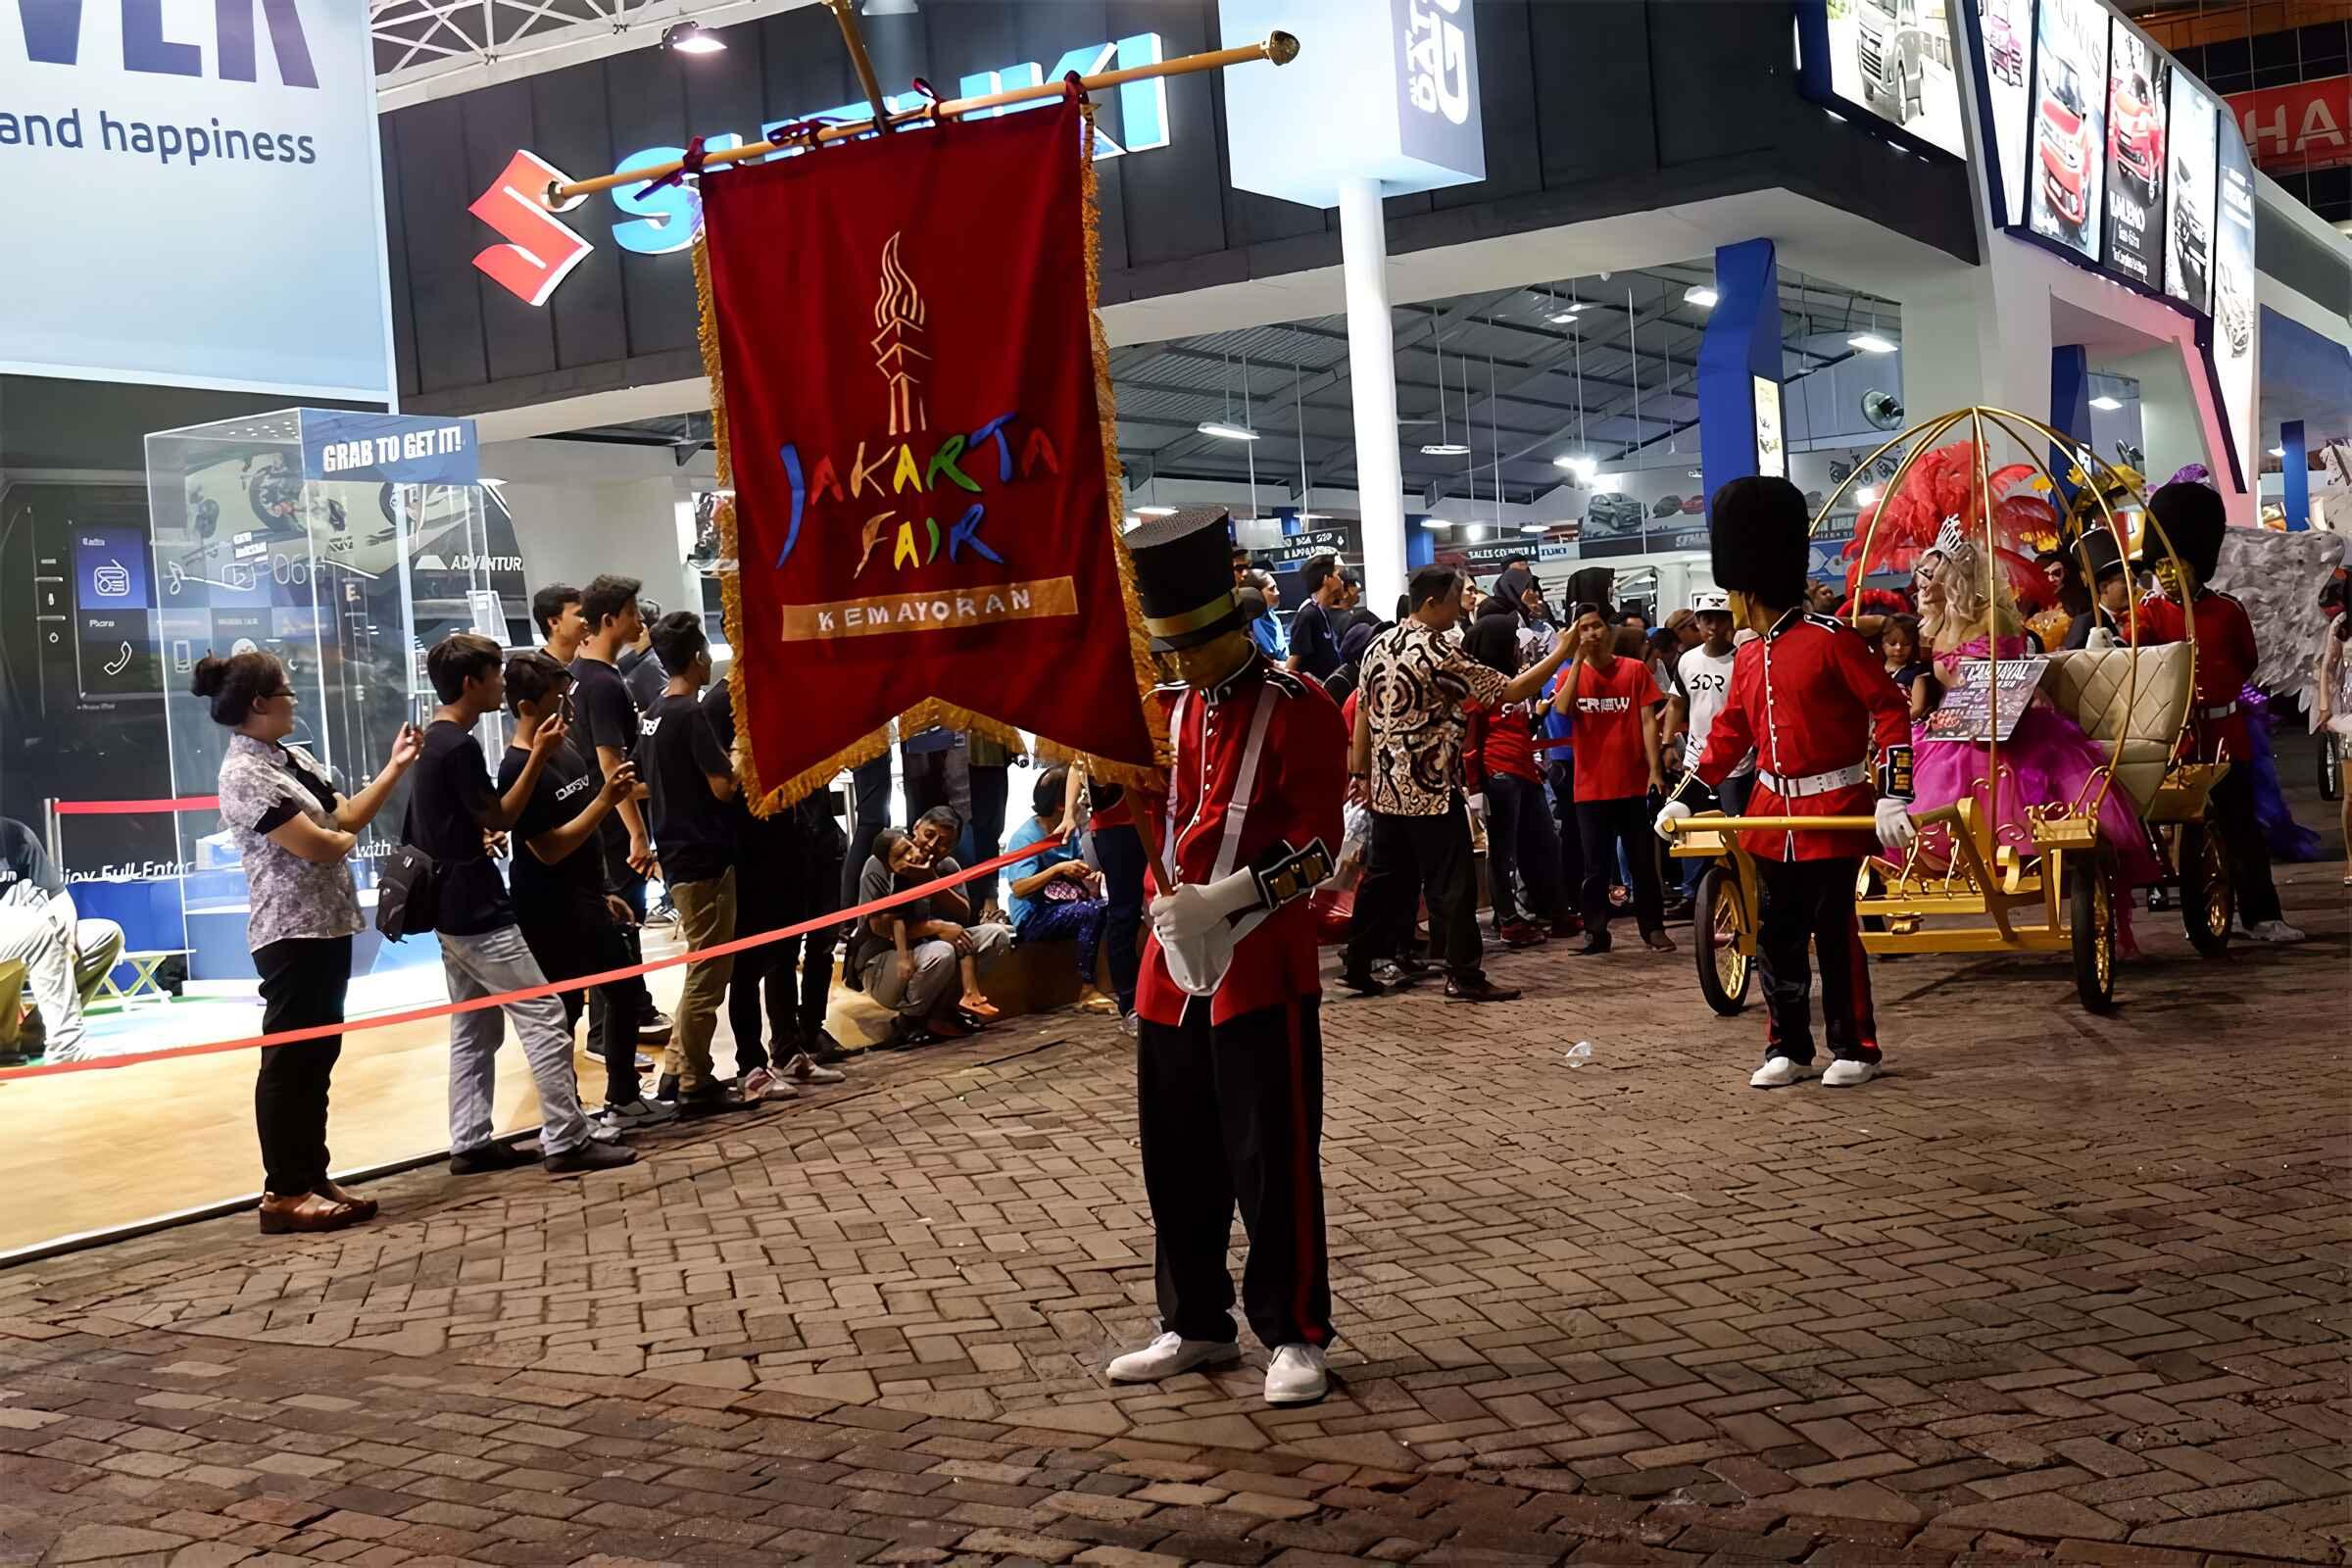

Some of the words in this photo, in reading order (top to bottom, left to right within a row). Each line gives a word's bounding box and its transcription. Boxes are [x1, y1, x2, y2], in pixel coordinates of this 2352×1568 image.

[0, 108, 82, 148] and
[100, 110, 316, 166] happiness
[2244, 96, 2352, 158] HA
[322, 439, 374, 472] GRAB
[376, 435, 400, 464] TO
[404, 429, 435, 459] GET
[438, 425, 462, 454] IT!
[775, 411, 1059, 569] JAKARTA
[451, 555, 523, 571] ADVENTUR
[854, 503, 1004, 579] FAIR
[817, 586, 1032, 632] KEMAYORAN
[64, 867, 96, 884] joy
